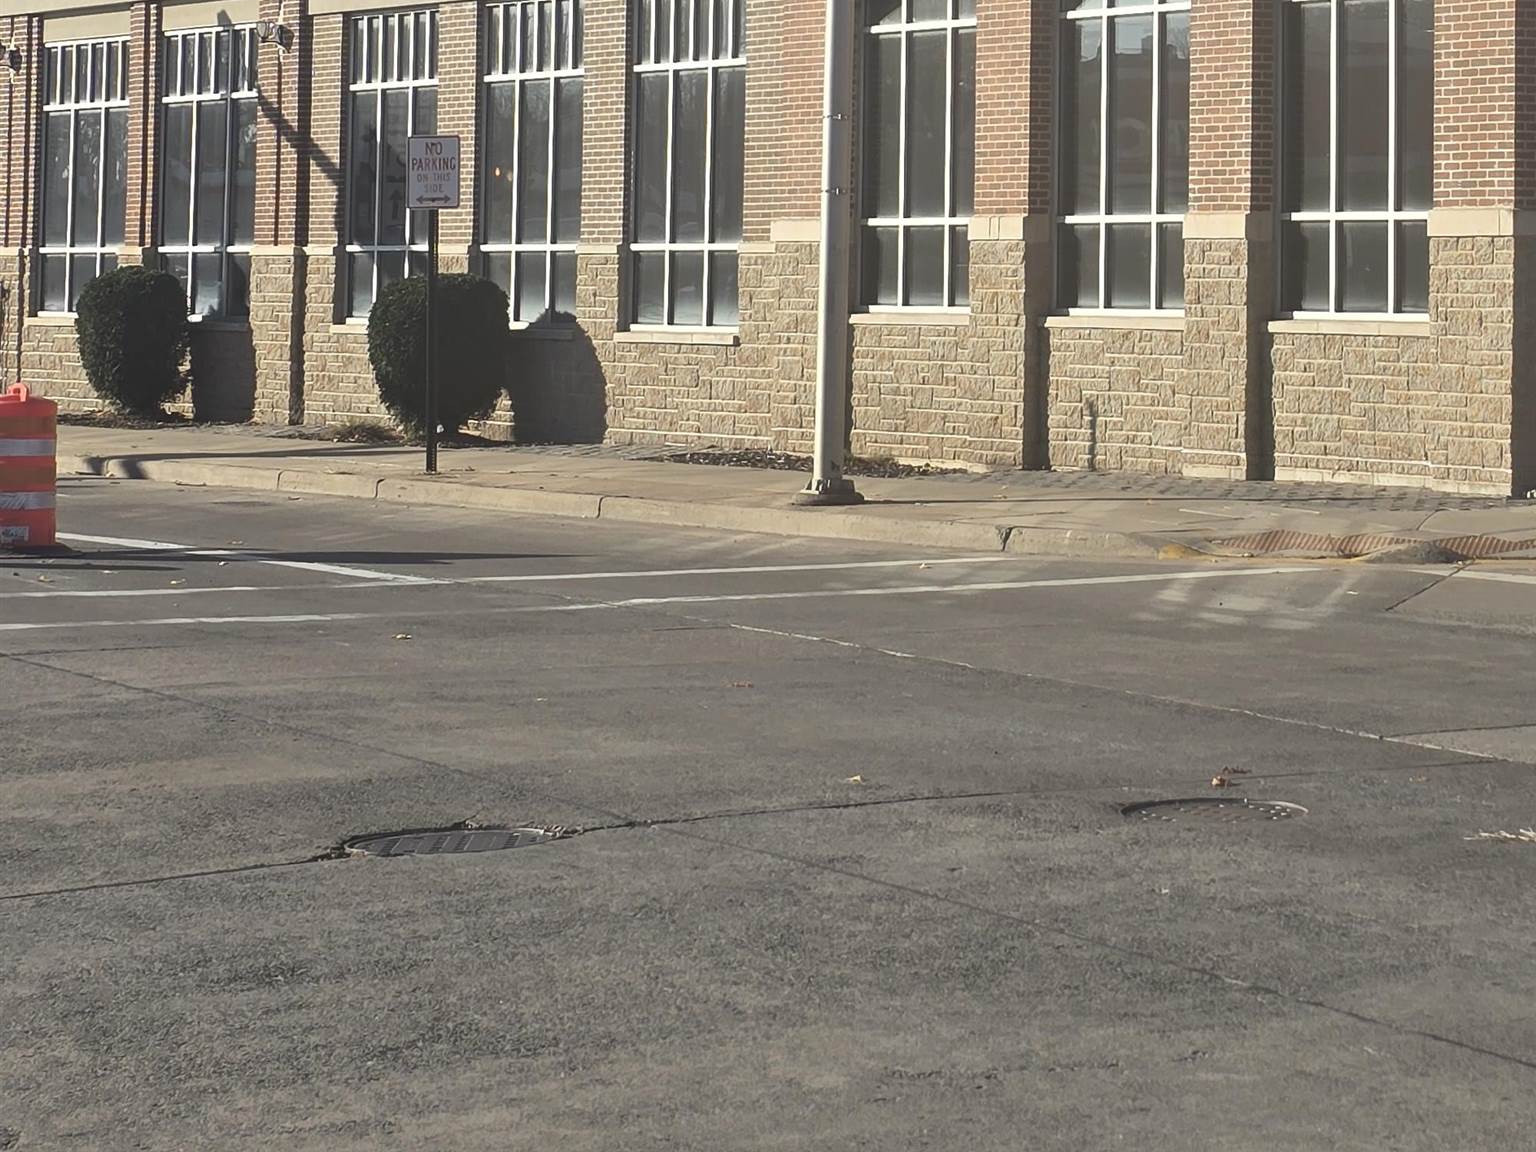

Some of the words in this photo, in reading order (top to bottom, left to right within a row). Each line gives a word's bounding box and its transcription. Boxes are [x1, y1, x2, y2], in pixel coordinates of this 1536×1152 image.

[425, 141, 443, 155] NO
[412, 156, 456, 171] PARKING
[417, 173, 429, 183] ON
[433, 172, 451, 182] THIS
[424, 183, 445, 193] SIDE
